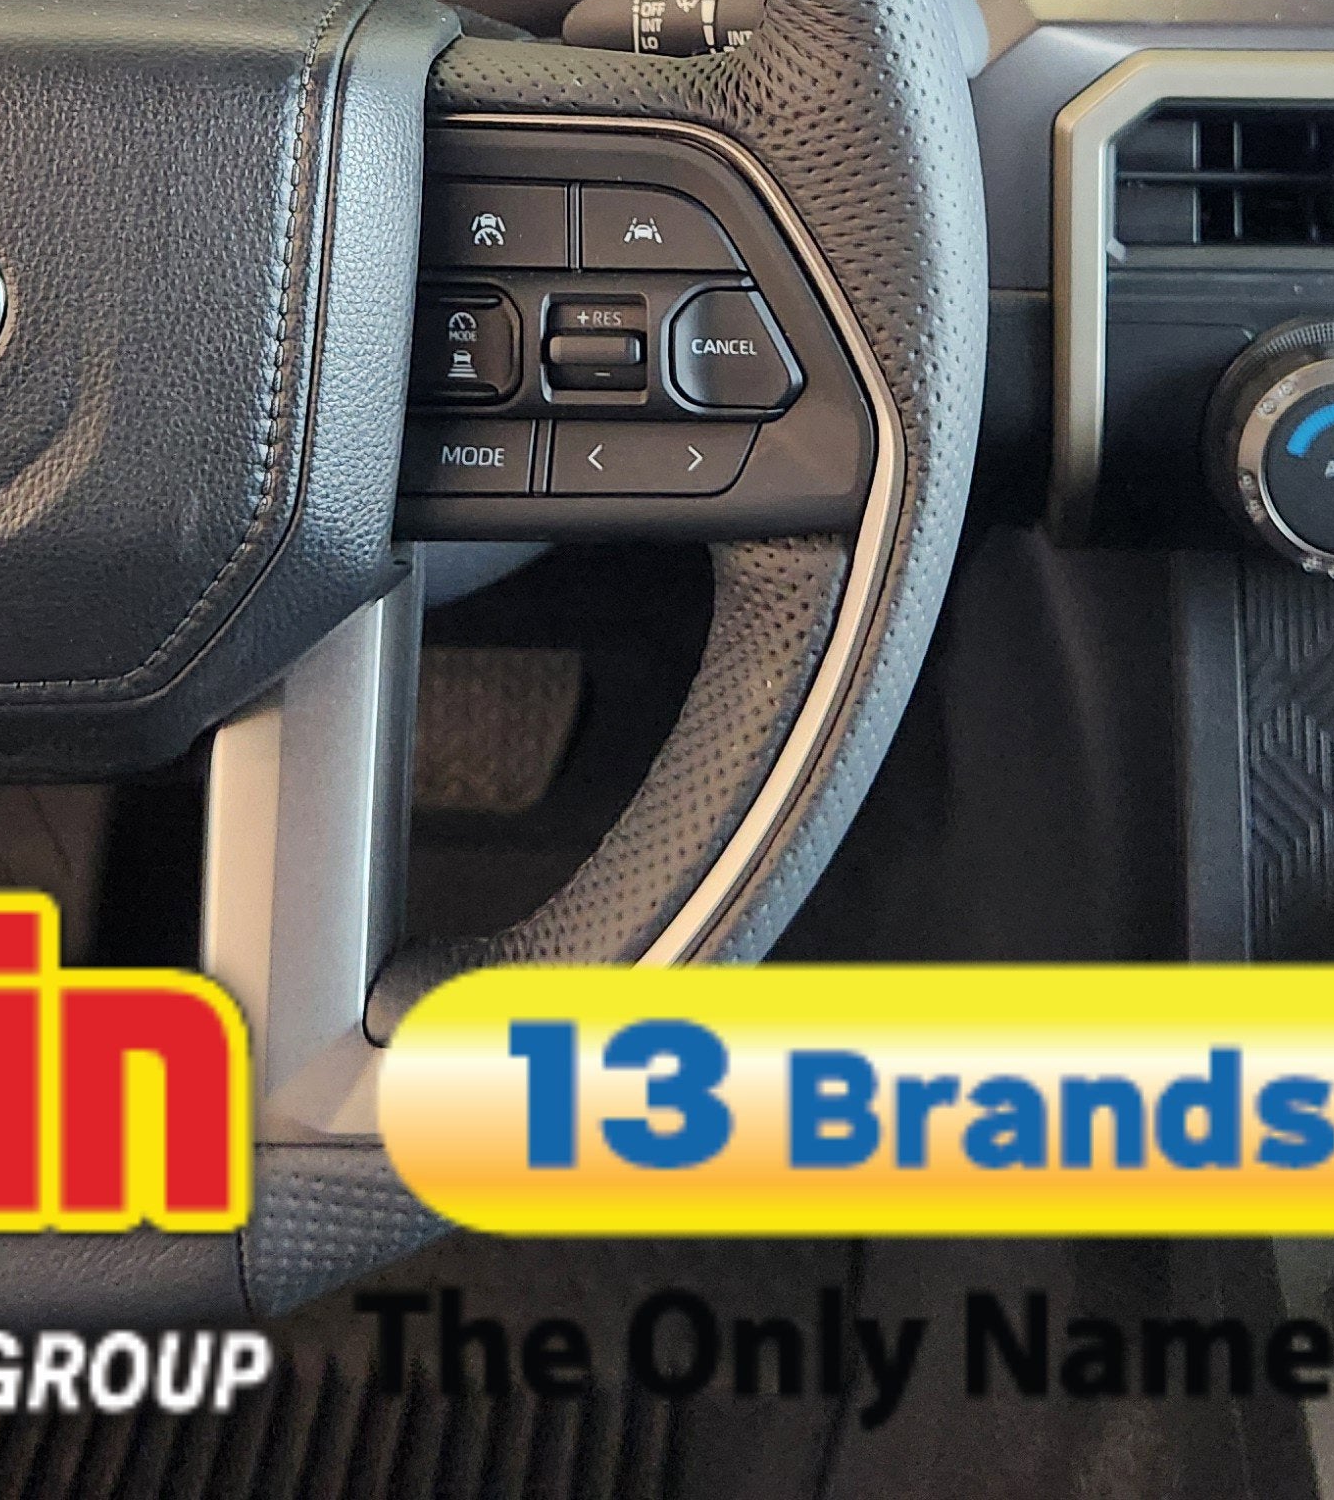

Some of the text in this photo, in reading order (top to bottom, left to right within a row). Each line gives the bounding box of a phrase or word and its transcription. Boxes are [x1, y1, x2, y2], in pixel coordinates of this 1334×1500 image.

[641, 1, 666, 17] OFF
[641, 18, 663, 32] INT
[641, 36, 659, 50] LO
[727, 30, 753, 46] INT
[448, 332, 478, 342] MODE
[691, 338, 758, 356] CANCEL
[442, 446, 506, 467] MODE
